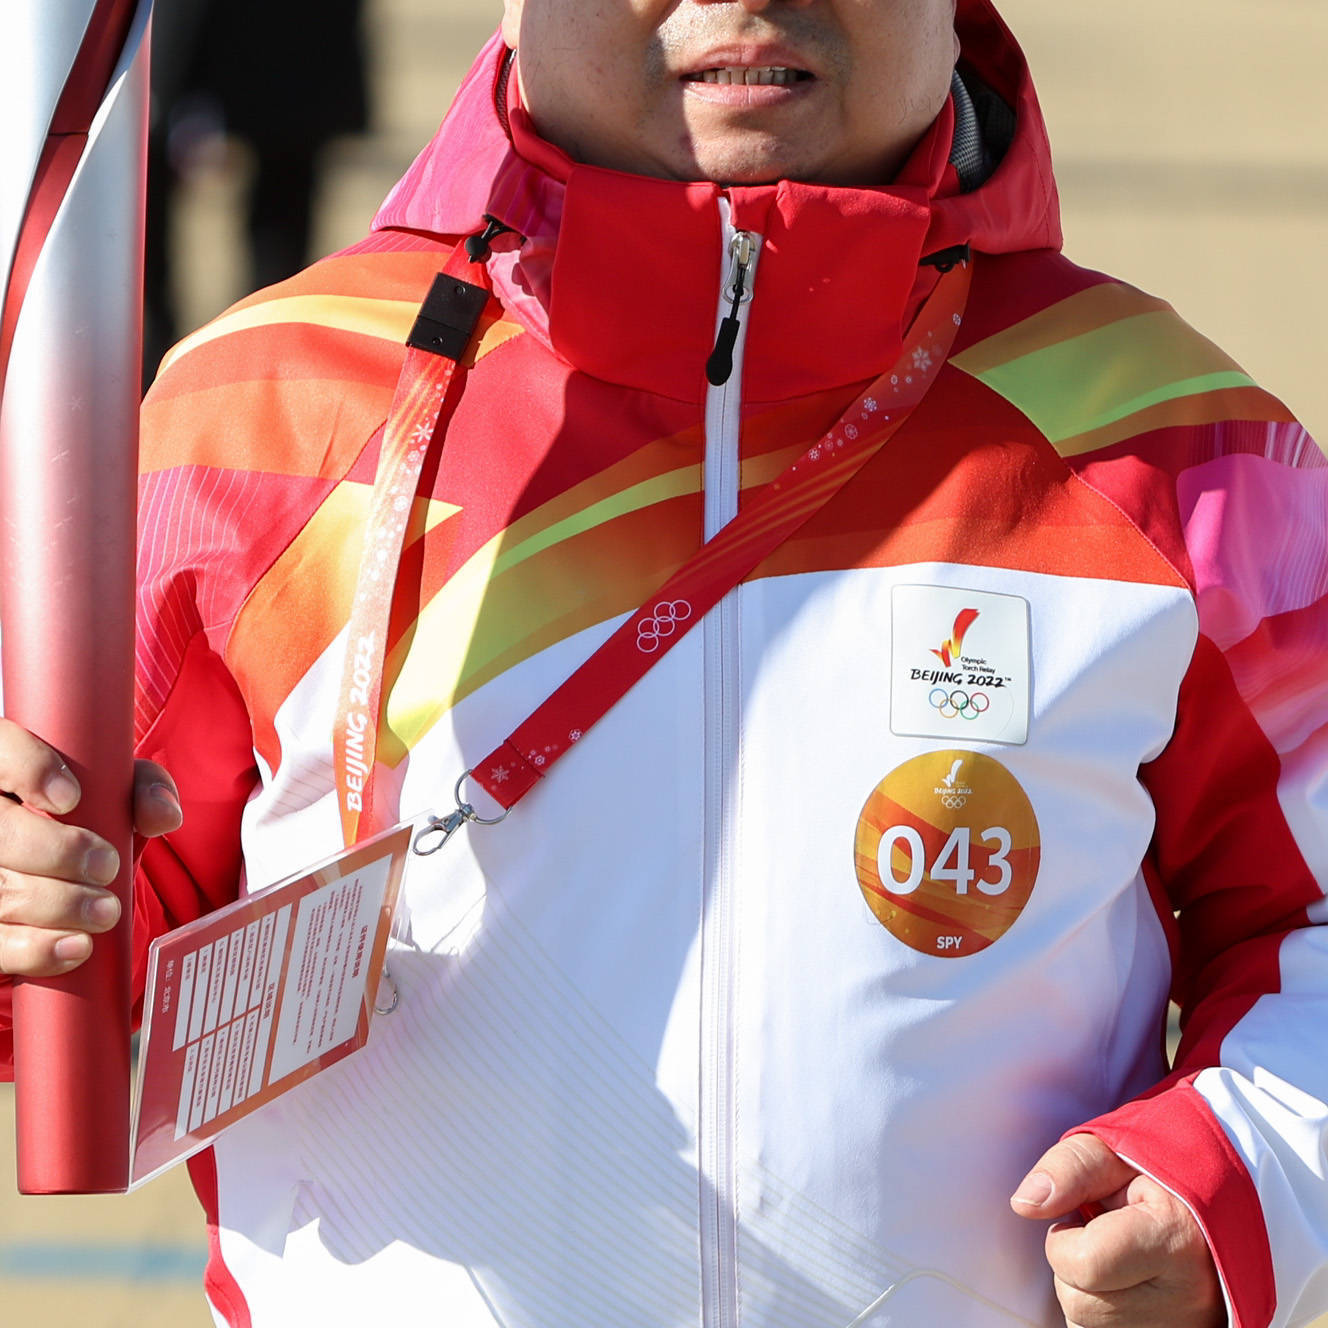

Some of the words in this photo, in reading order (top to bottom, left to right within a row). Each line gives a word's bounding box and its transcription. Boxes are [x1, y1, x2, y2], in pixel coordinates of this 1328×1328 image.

[349, 630, 376, 707] 2022
[961, 656, 987, 665] Olympic
[962, 664, 978, 672] Torch
[910, 668, 963, 685] BEIJING
[967, 674, 1006, 688] 2022
[345, 711, 369, 813] BEIJING
[877, 825, 1012, 896] 043
[936, 936, 962, 949] SPY
